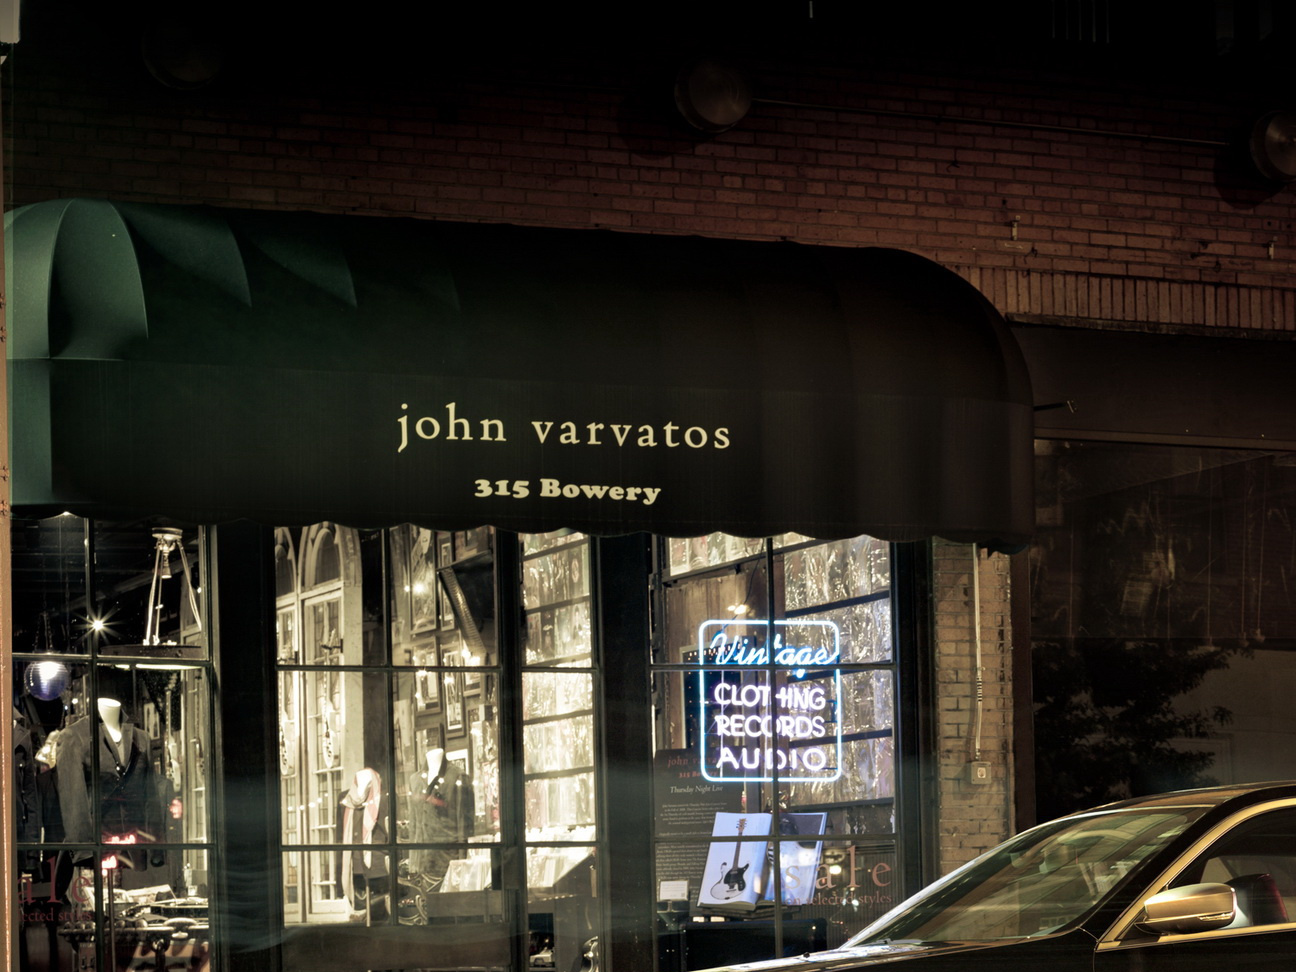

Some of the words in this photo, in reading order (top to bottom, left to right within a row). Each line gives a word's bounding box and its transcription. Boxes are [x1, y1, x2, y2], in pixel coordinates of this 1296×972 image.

[398, 402, 507, 453] john
[531, 421, 731, 449] varvatos
[474, 479, 530, 499] 315
[539, 478, 662, 505] Bowery
[710, 632, 839, 678] Vintage
[714, 682, 826, 710] CLOTHING
[715, 714, 826, 738] RECORDS
[716, 747, 827, 771] AUDIO
[17, 855, 92, 904] ale
[785, 845, 892, 889] sale
[859, 890, 892, 908] styles
